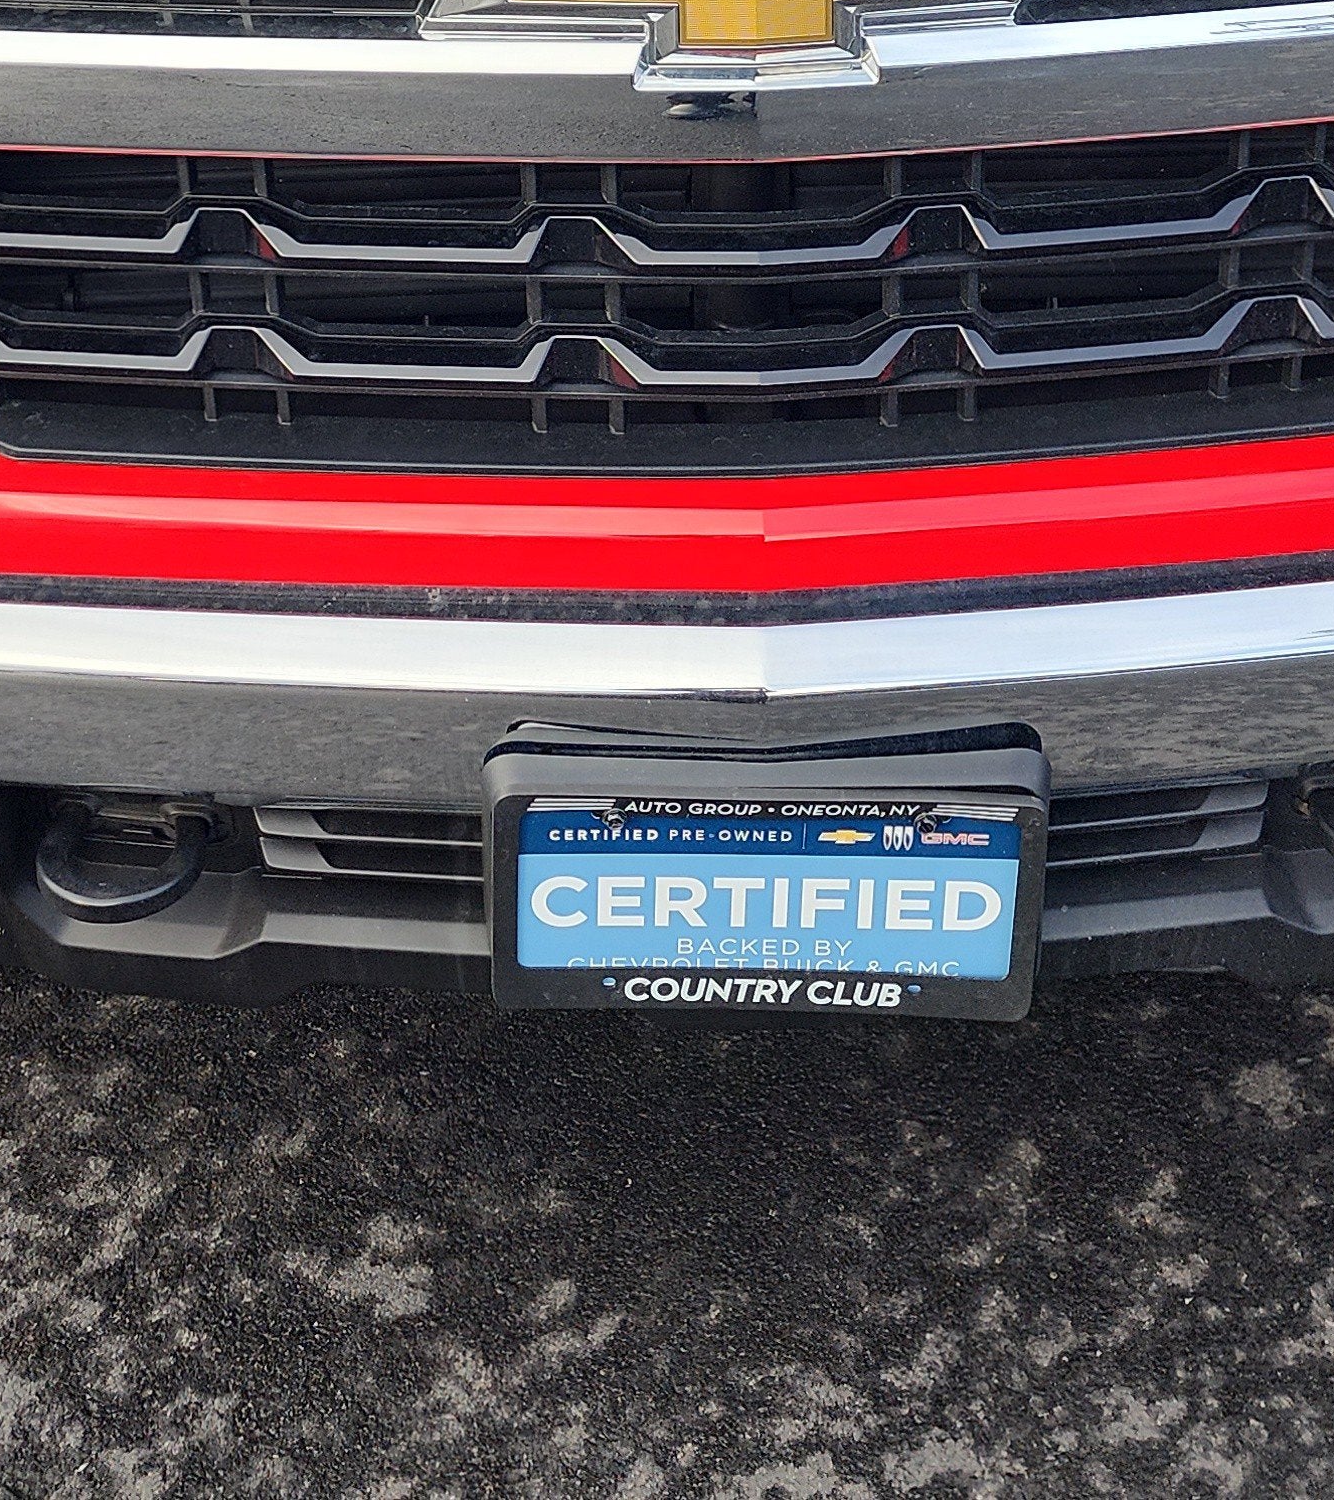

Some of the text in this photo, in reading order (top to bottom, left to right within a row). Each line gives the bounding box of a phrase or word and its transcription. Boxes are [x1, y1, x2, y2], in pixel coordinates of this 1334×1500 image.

[624, 801, 920, 818] AUTO GROUP ONEONTA, NY
[548, 828, 793, 843] CERTIFIED PRE-OWNED
[920, 832, 990, 846] GMC
[530, 875, 1002, 932] CERTIFIED
[677, 938, 853, 957] BACKED BY
[894, 960, 960, 977] GMC
[624, 977, 902, 1008] COUNTRY CLUB
